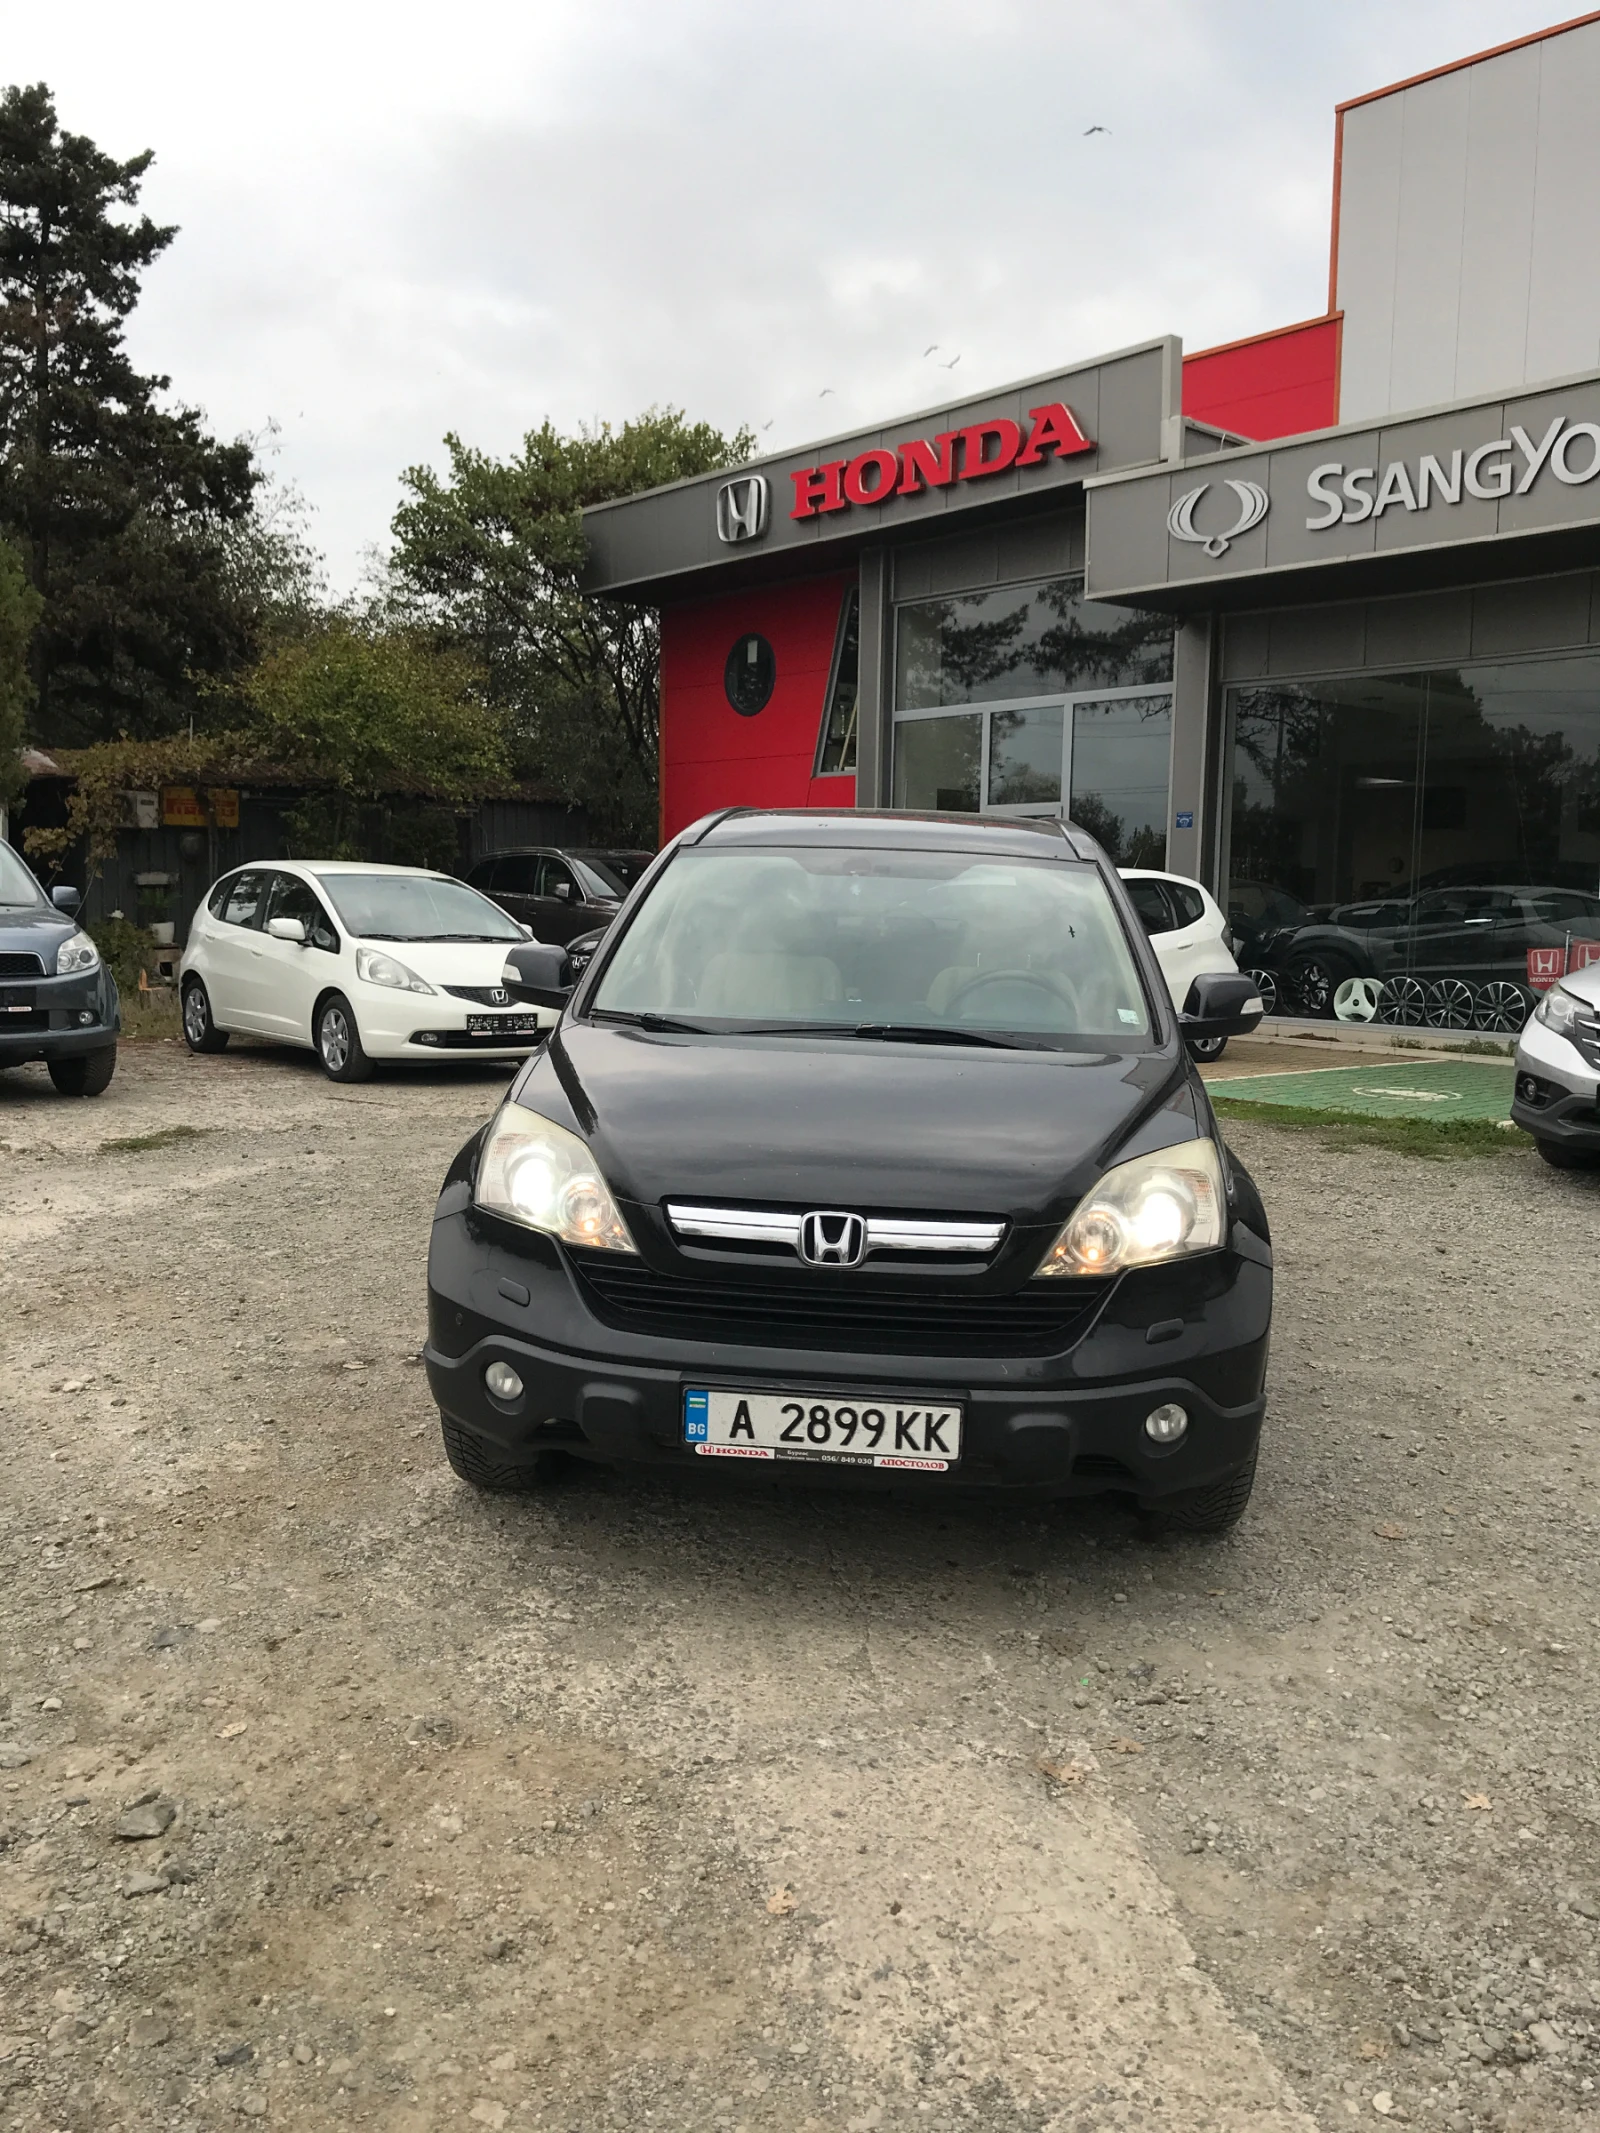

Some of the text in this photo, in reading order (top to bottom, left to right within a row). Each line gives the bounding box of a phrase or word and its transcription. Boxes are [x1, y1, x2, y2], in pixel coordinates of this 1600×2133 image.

[789, 402, 1096, 520] HONDA
[1306, 416, 1600, 530] SSANGYO
[729, 1400, 755, 1439] A
[688, 1423, 705, 1436] BG
[715, 1447, 769, 1457] HONDA
[840, 1456, 856, 1464] 849
[857, 1457, 873, 1465] 030
[879, 1458, 945, 1470] АПОСТОЛОВ
